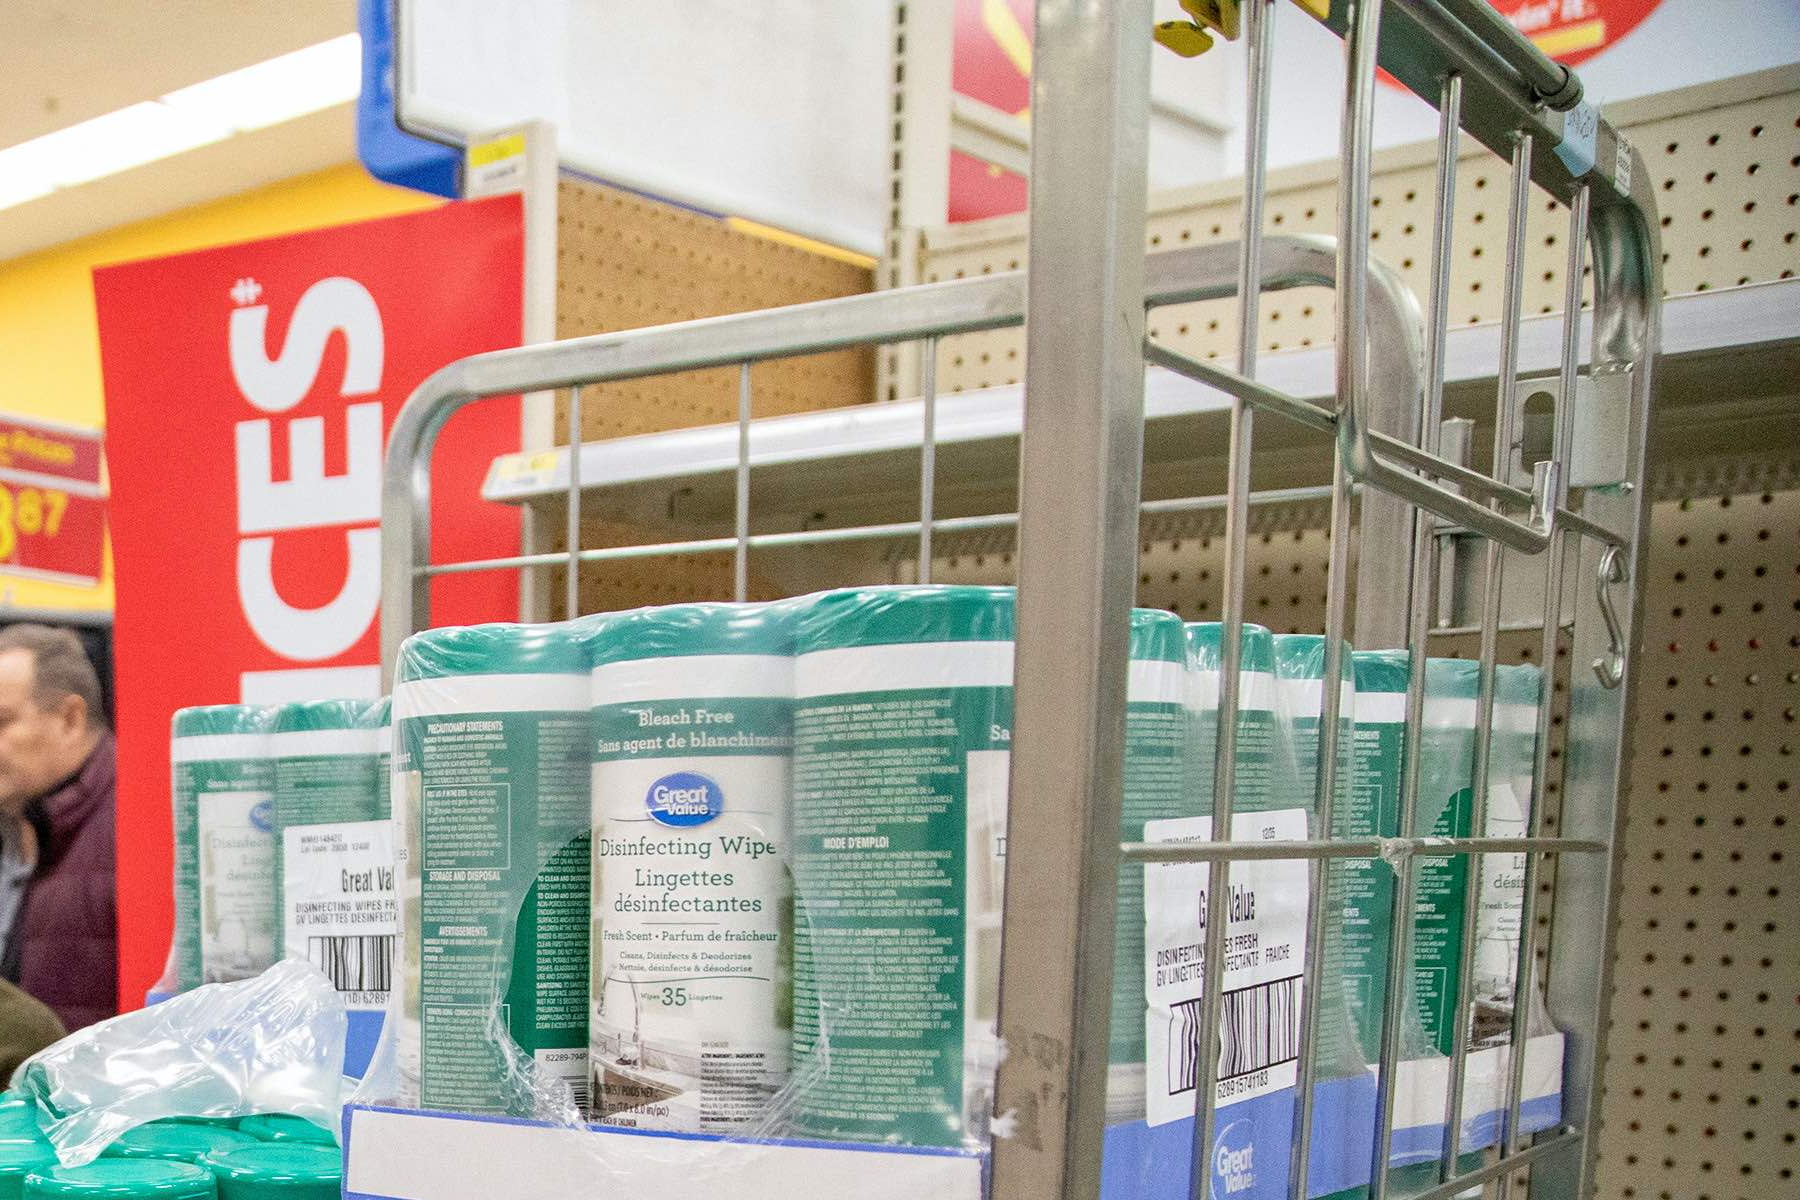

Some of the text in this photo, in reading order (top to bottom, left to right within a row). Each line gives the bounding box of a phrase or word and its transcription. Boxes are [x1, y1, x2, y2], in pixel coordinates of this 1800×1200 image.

[638, 708, 735, 727] Bleach Free
[623, 736, 663, 754] agent
[666, 732, 686, 748] de
[654, 785, 709, 804] Great
[667, 802, 709, 816] Value
[600, 836, 712, 860] Disinfecting
[341, 868, 373, 893] Great
[634, 868, 735, 891] Lingettes
[614, 892, 763, 914] désinfectantes
[625, 929, 653, 941] Scent
[661, 930, 704, 942] Parfum
[707, 929, 723, 942] de
[724, 929, 779, 942] fraîcheur
[661, 987, 687, 1006] 35
[1217, 1143, 1254, 1178] Great
